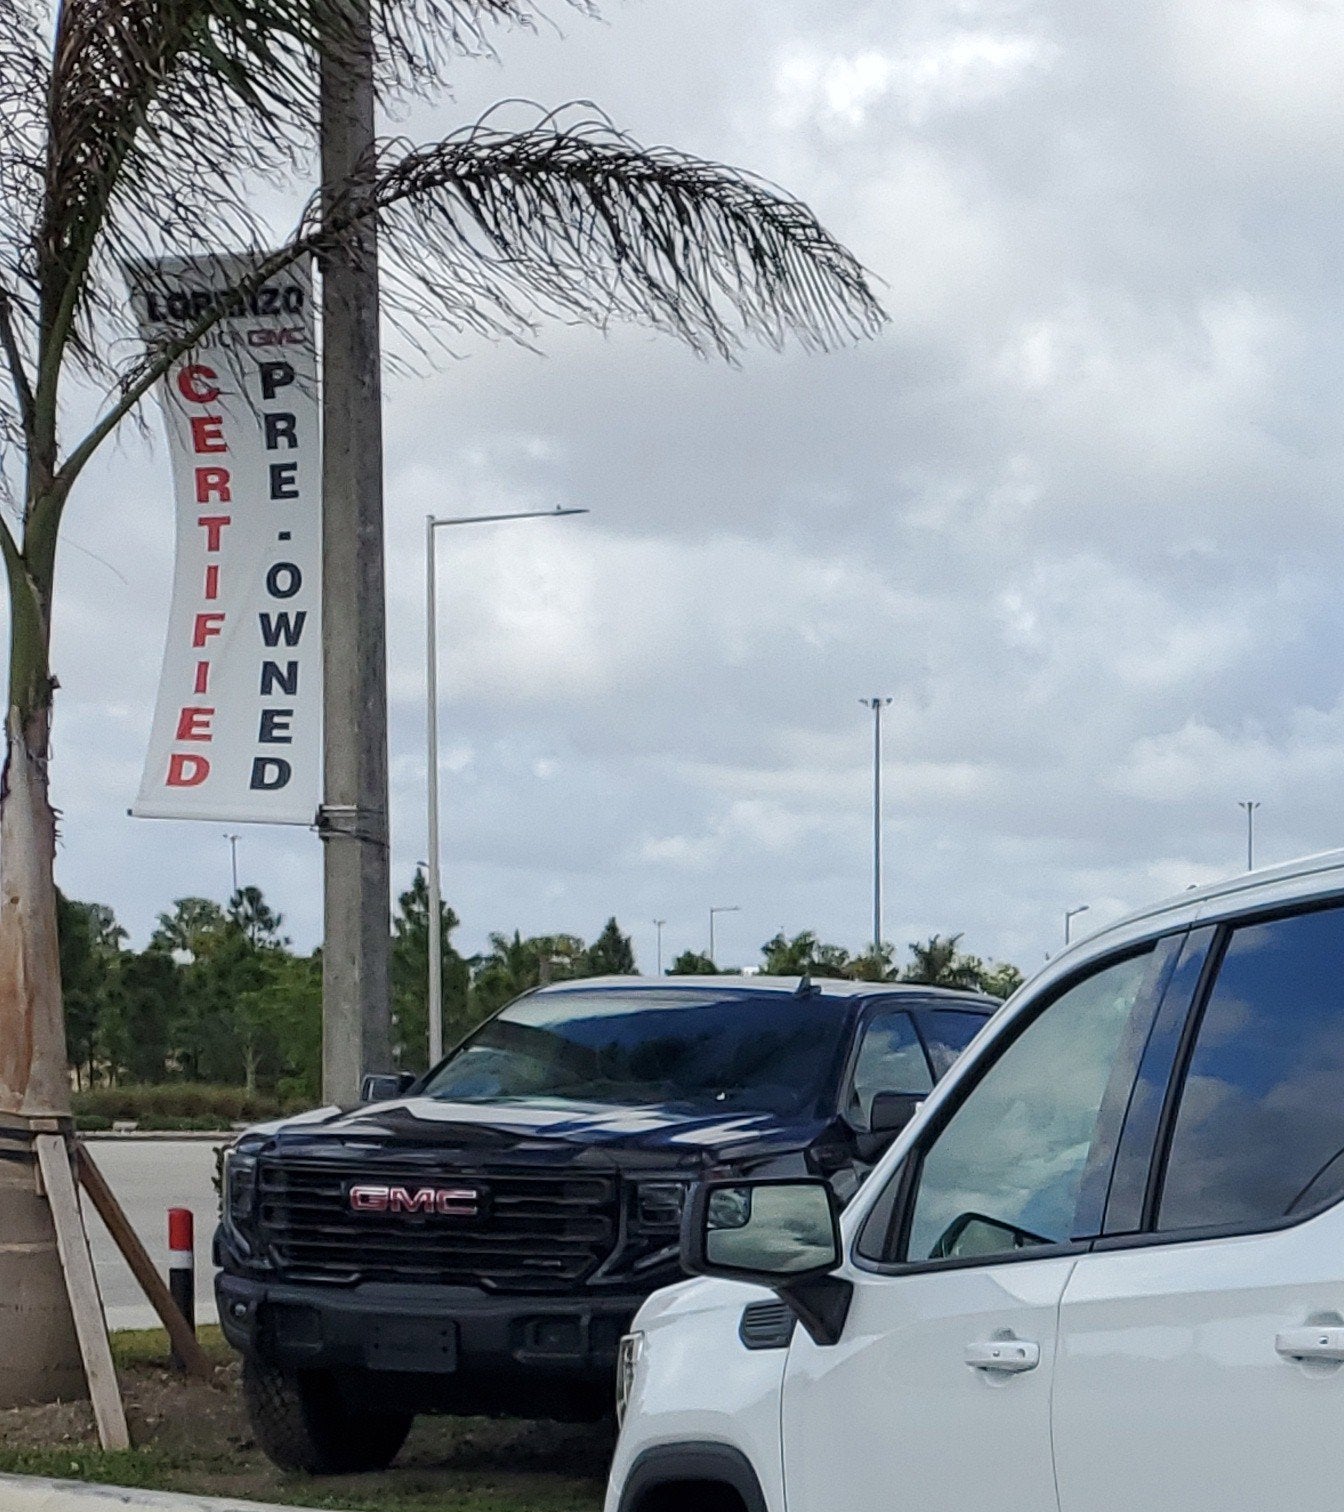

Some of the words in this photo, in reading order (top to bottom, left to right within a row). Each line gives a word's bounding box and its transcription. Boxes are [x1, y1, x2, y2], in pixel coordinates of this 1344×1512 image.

[248, 327, 306, 346] GMC
[164, 363, 233, 788] CERTIFIED
[248, 361, 307, 791] PRE-OWNED
[349, 1185, 479, 1215] GMC
